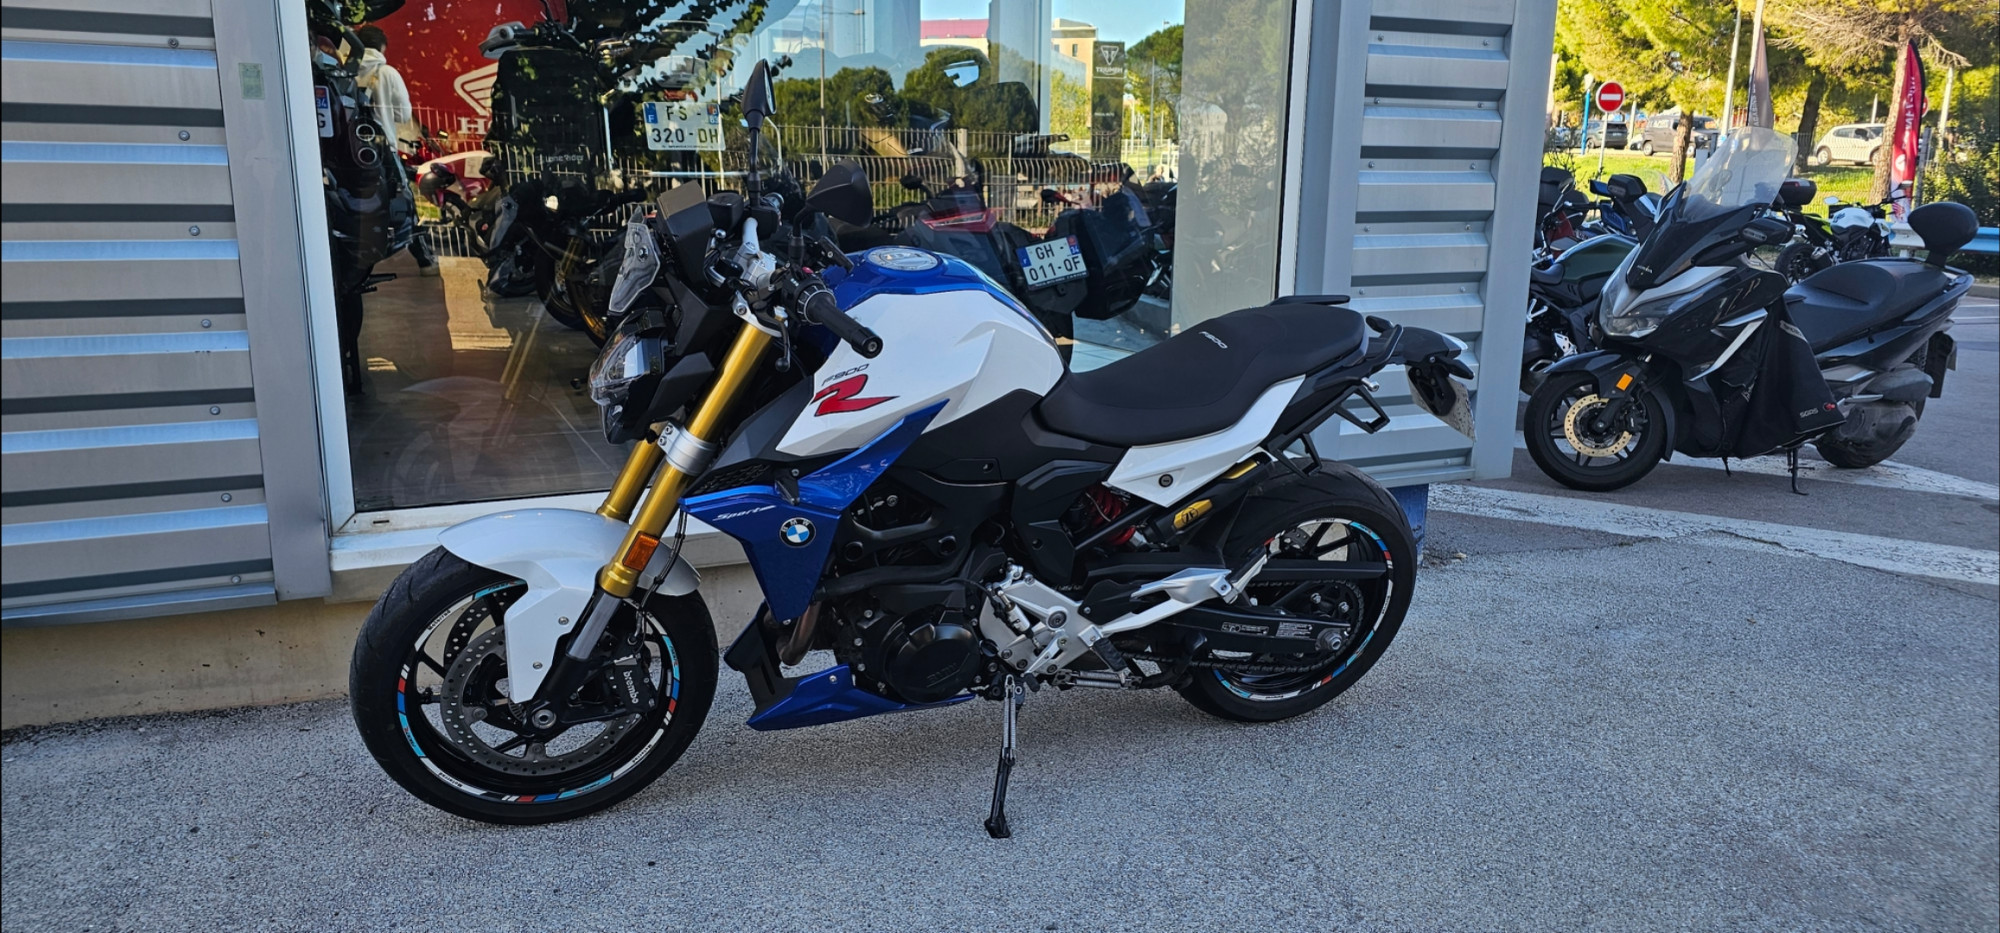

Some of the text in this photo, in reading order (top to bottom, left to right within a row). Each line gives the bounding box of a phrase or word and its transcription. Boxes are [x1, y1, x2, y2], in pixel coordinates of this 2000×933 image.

[1096, 66, 1123, 74] TRIUMPH
[666, 105, 688, 121] FS
[652, 128, 718, 143] 320-DH
[1035, 244, 1055, 260] GH
[821, 363, 870, 387] F900
[809, 373, 900, 417] R
[623, 670, 639, 704] brembo
